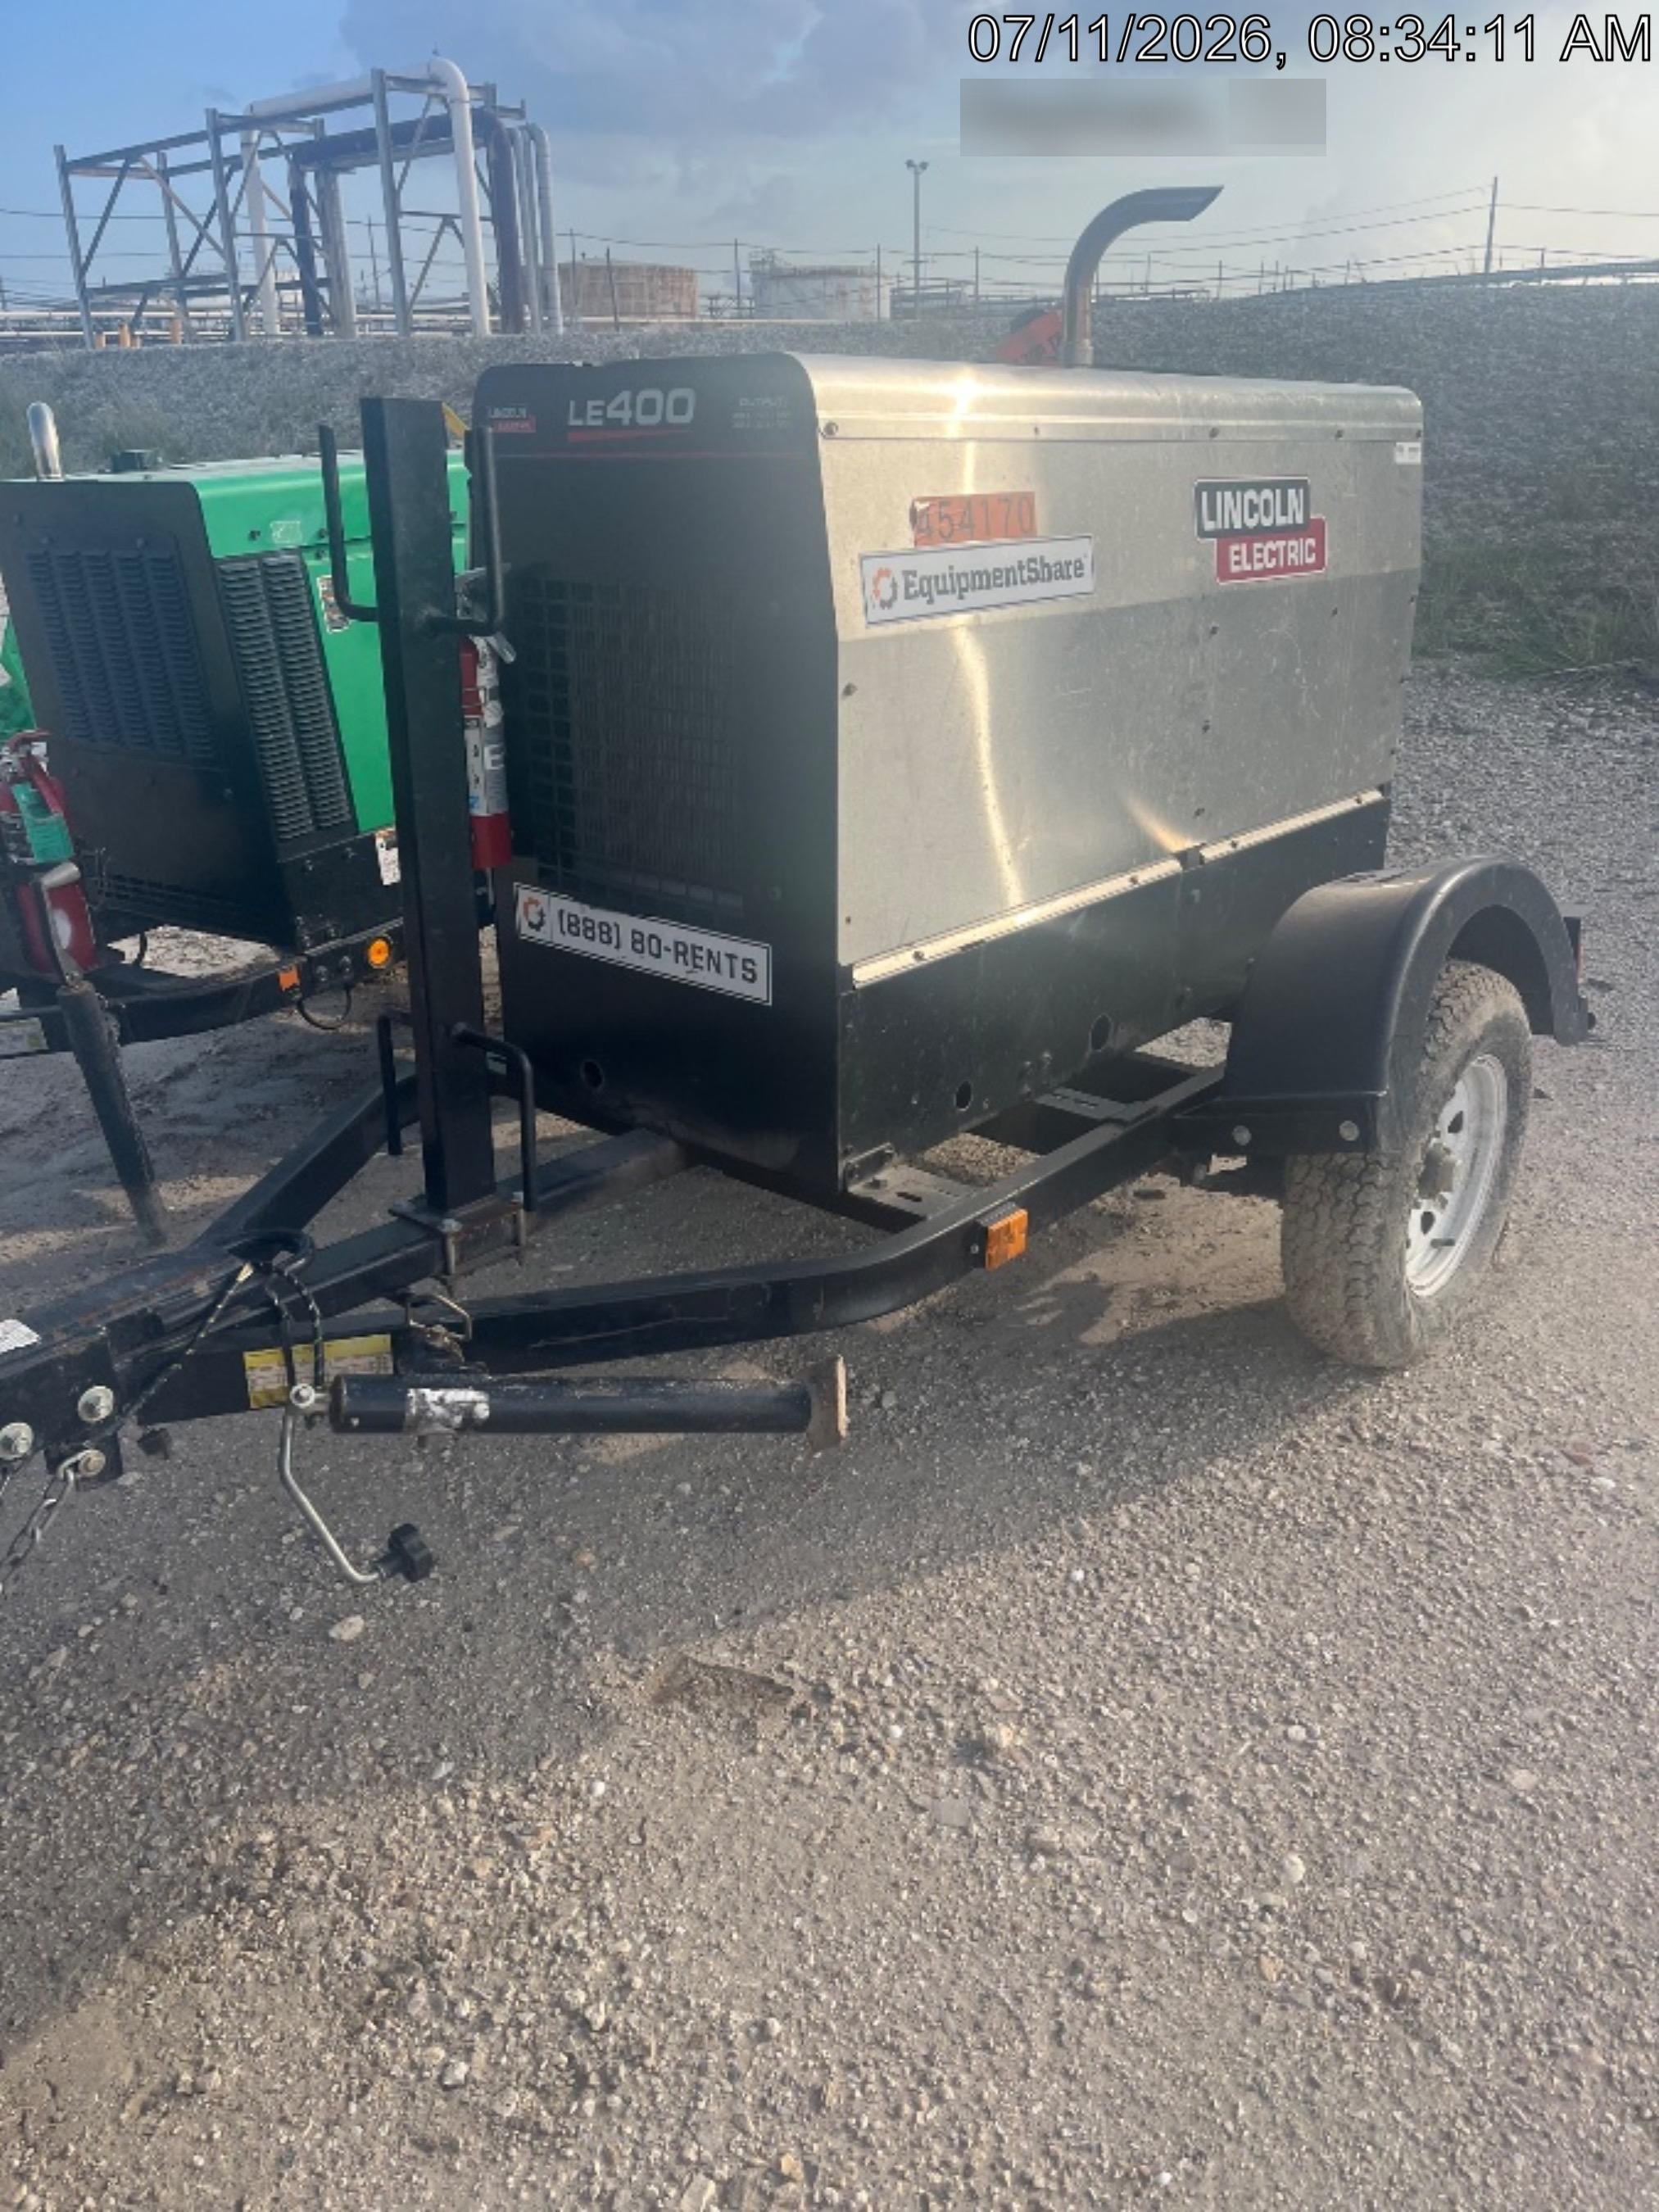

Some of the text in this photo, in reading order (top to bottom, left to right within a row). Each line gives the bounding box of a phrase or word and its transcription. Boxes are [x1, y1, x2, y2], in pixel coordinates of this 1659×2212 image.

[568, 388, 696, 427] LE400
[1201, 487, 1305, 531] LINCOLN
[1230, 537, 1317, 573] ELECTRIC
[903, 555, 1086, 602] EquipmentShare
[558, 908, 758, 984] (888) 80-RENTS
